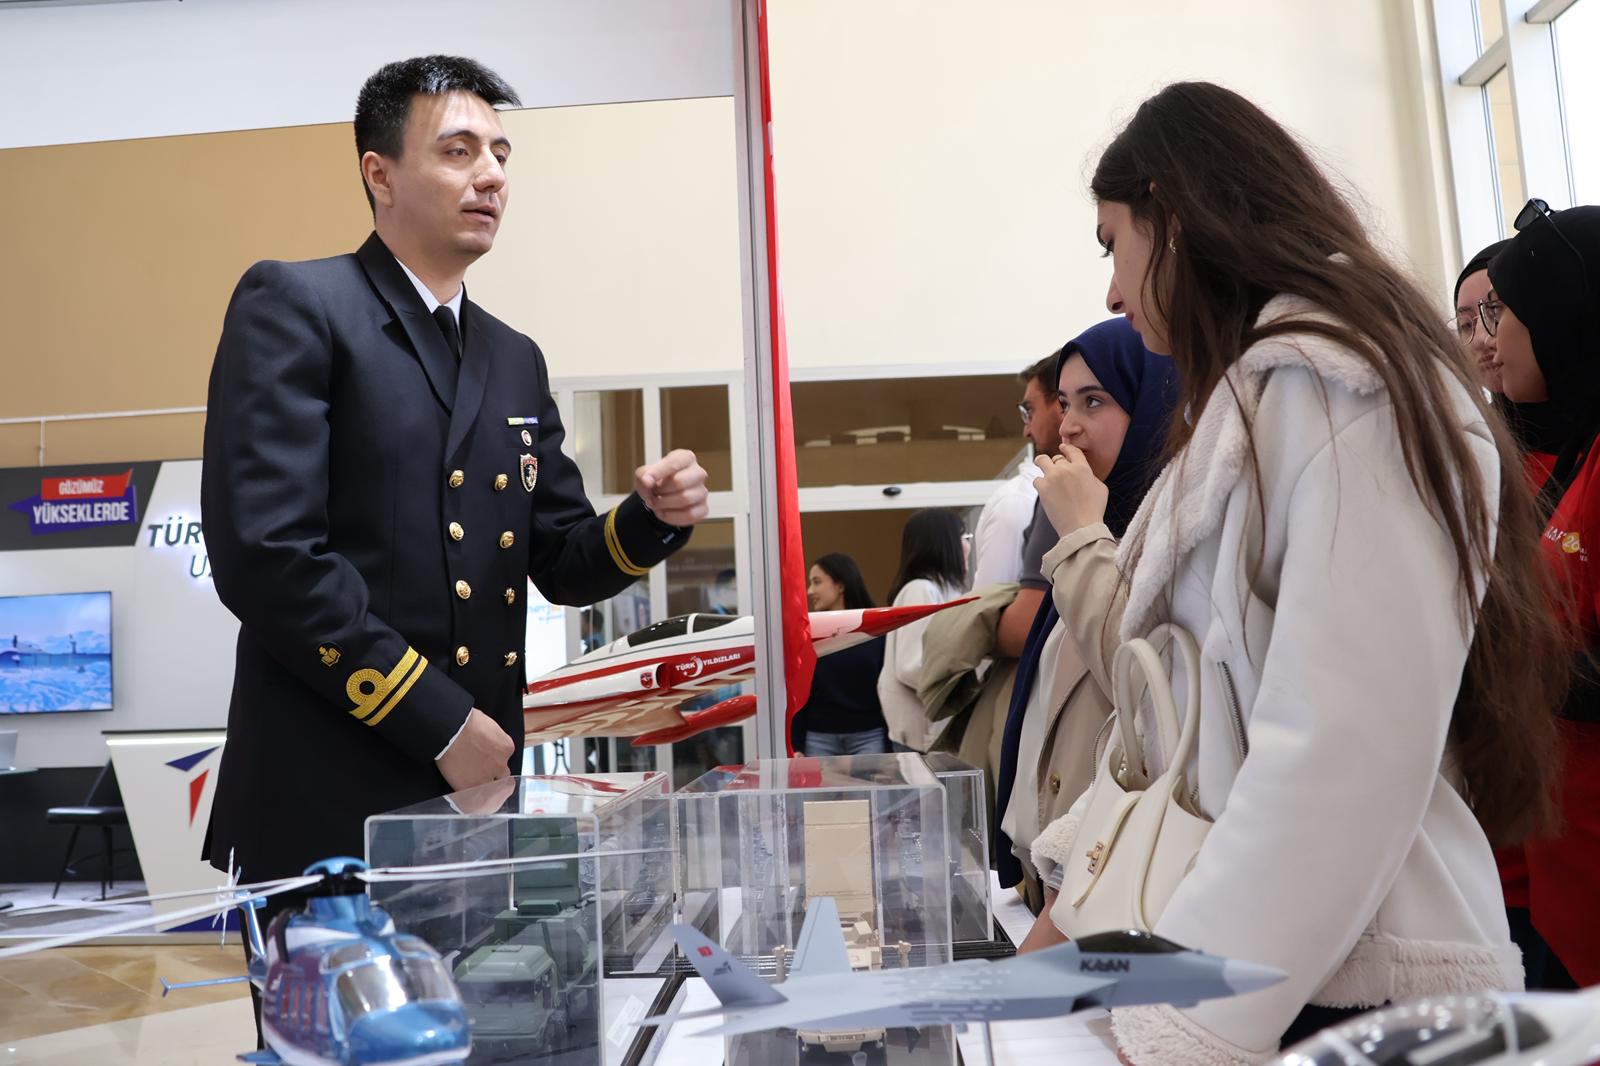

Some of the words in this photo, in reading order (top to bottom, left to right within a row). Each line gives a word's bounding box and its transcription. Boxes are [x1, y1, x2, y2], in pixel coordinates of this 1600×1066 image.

[58, 478, 104, 495] GÖZÜMÜZ
[33, 502, 130, 524] YÜKSEKLERDE
[190, 554, 213, 578] U
[675, 661, 696, 672] TÜRK
[703, 653, 741, 666] YILDIZLARI
[1079, 958, 1131, 973] KAAN
